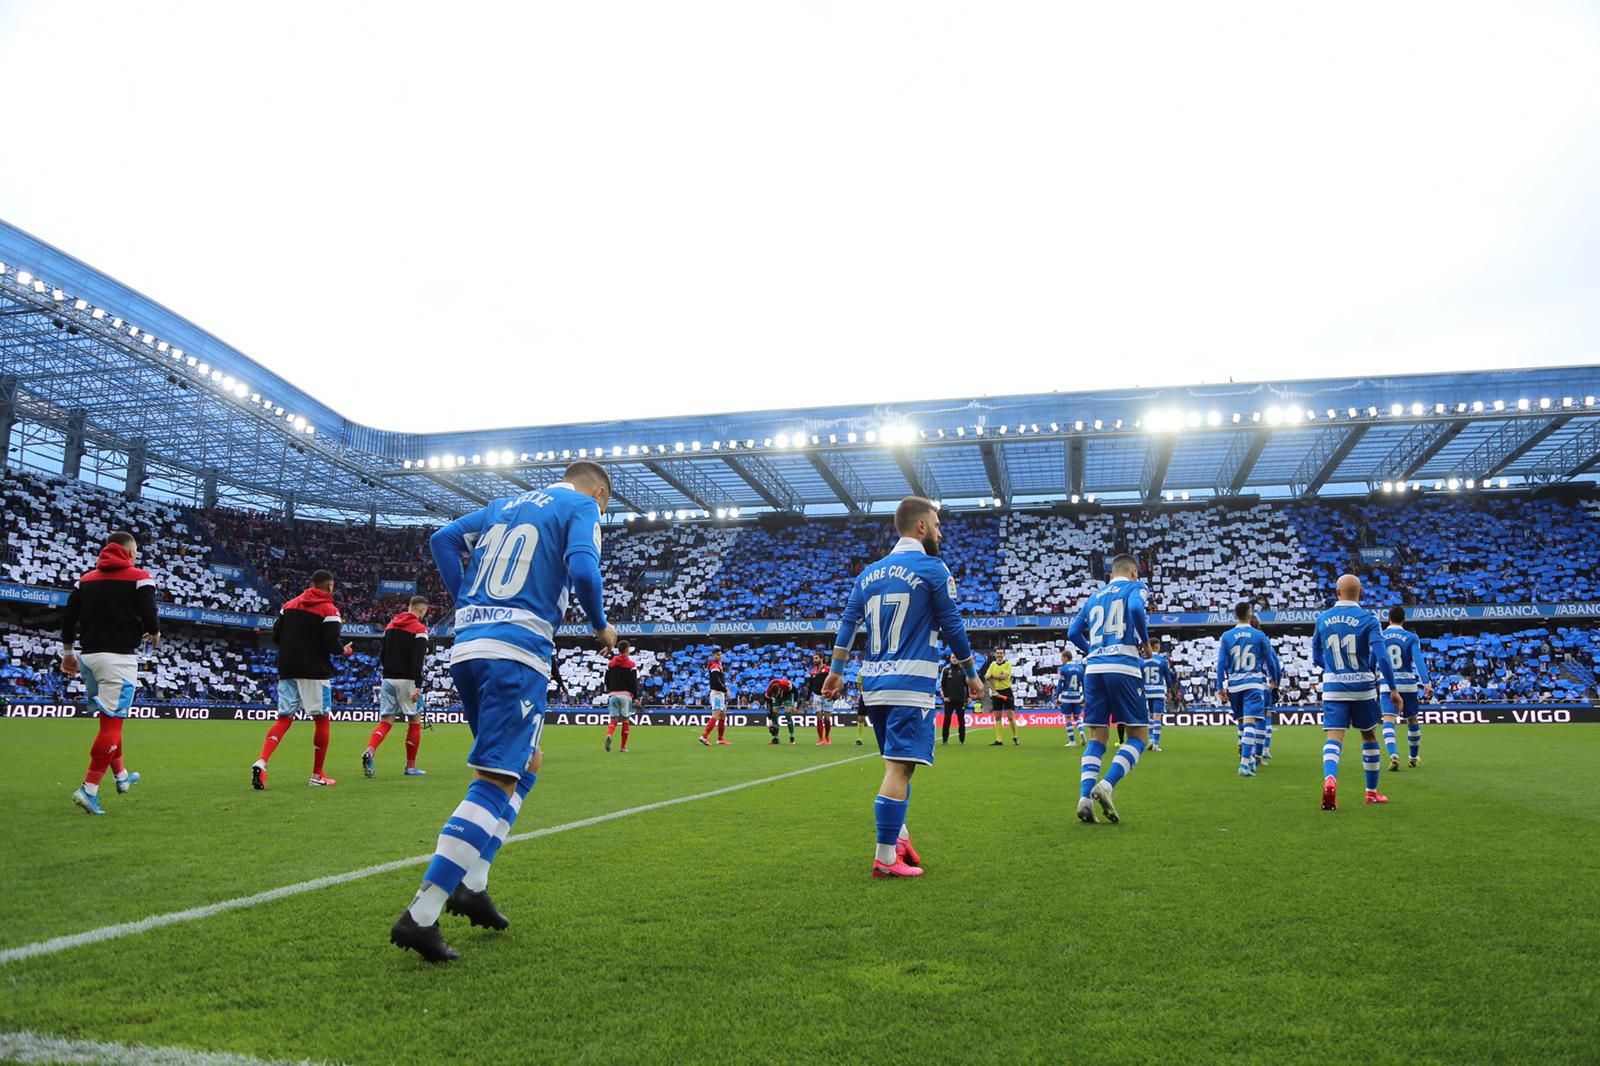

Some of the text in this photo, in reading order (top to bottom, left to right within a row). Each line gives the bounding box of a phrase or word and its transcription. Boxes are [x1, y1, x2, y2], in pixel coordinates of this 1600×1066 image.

[467, 523, 539, 600] 10
[861, 567, 886, 590] EMRE
[0, 587, 50, 601] rella Galicia
[1089, 598, 1127, 646] 24
[1278, 610, 1322, 622] ABANC
[1324, 614, 1360, 628] MOLLEJO
[341, 624, 371, 634] ANCA
[556, 624, 589, 635] BANCA
[615, 623, 642, 634] ANCA
[864, 592, 910, 655] 17
[1230, 643, 1256, 672] 16
[1326, 633, 1360, 671] 11
[1387, 644, 1403, 670] 8
[1069, 674, 1078, 690] 4
[1143, 666, 1160, 684] 15
[175, 708, 210, 719] VIGO
[234, 709, 243, 720] A
[328, 711, 379, 722] MADRI
[557, 713, 569, 725] A
[1512, 709, 1571, 723] VIGO
